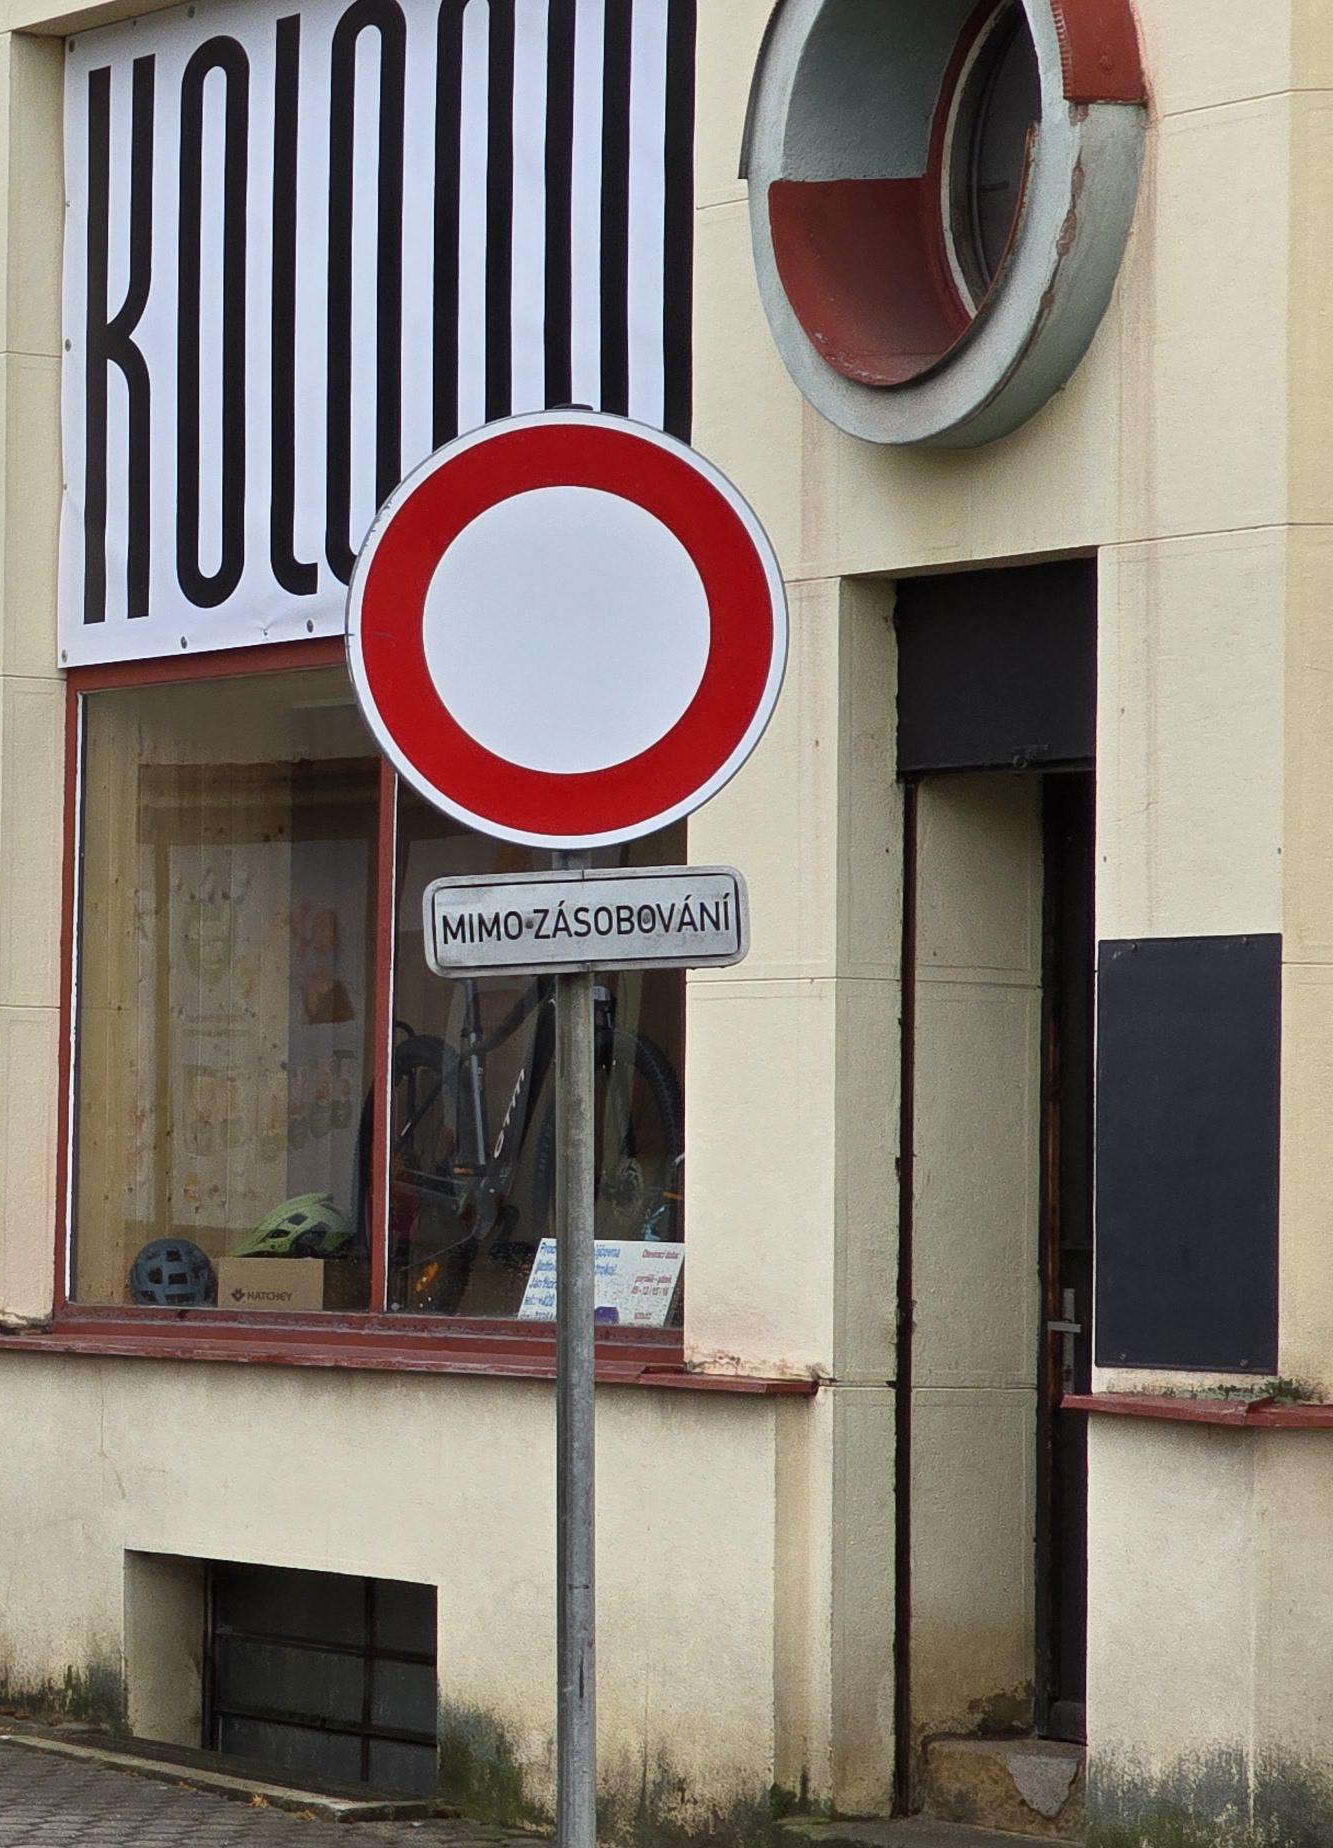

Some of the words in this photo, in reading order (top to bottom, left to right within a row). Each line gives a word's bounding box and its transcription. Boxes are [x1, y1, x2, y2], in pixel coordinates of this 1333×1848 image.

[441, 910, 523, 945] MIMO
[533, 892, 731, 940] ZÁSOBOVÁNÍ
[246, 1291, 293, 1301] HATCHEY
